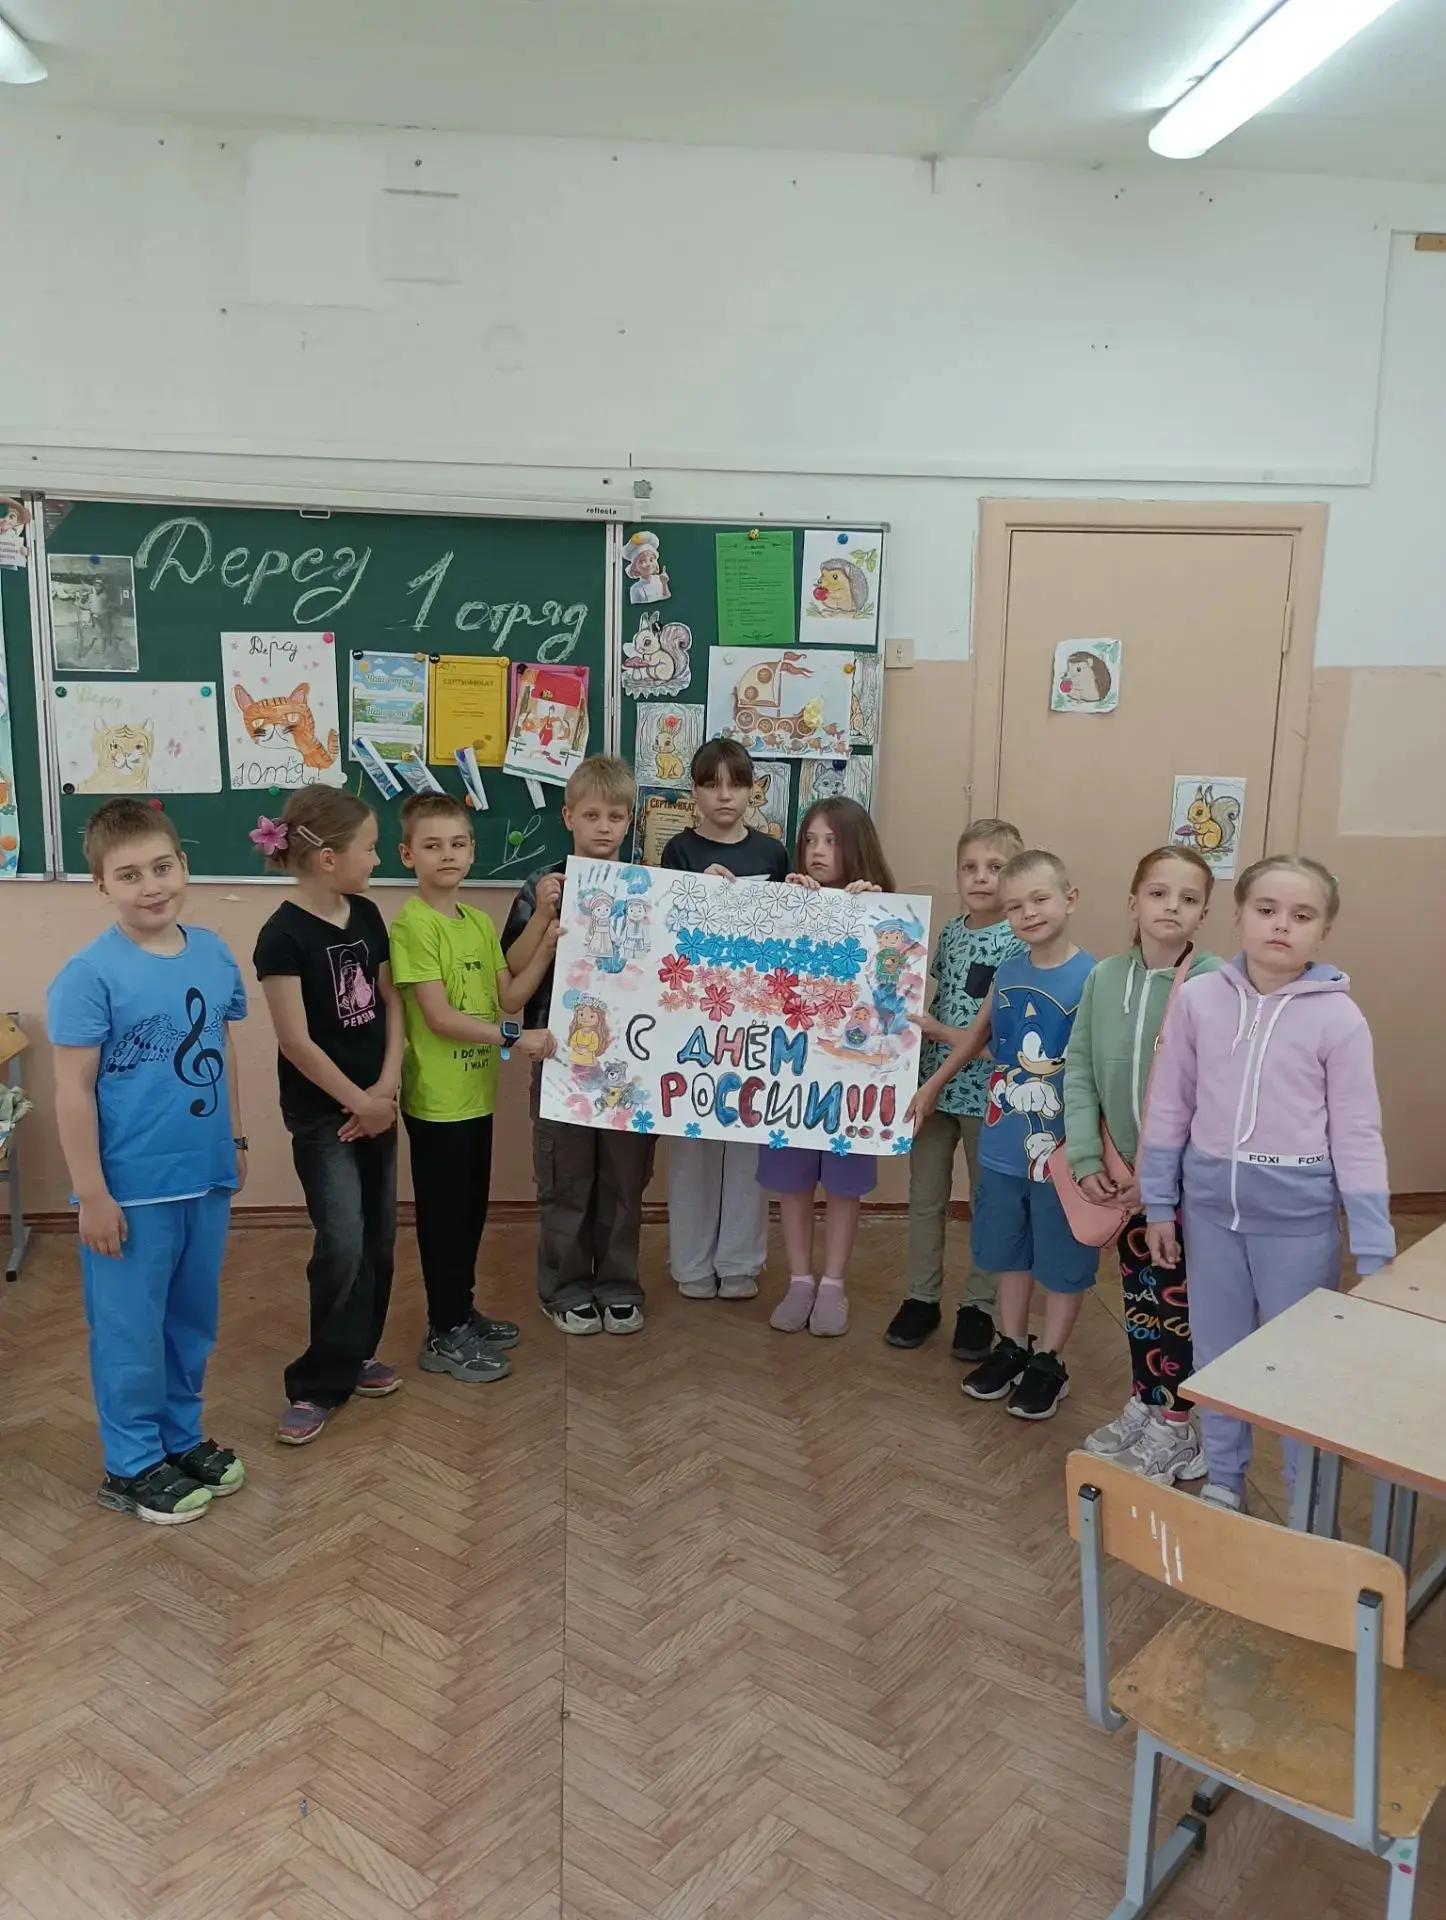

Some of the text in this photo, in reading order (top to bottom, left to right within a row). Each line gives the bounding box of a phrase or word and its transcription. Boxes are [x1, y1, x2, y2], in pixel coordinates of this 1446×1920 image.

[586, 506, 617, 515] reflecta
[134, 516, 588, 664] Дерсу 1 отряд
[249, 635, 298, 668] Дерсу
[626, 1014, 808, 1076] С ДНЁМ
[461, 1049, 475, 1059] DO
[470, 1058, 489, 1070] WANT
[660, 1071, 897, 1141] РОССИИ!!!
[1249, 1154, 1280, 1164] FOXI
[1298, 1154, 1325, 1165] FOXI
